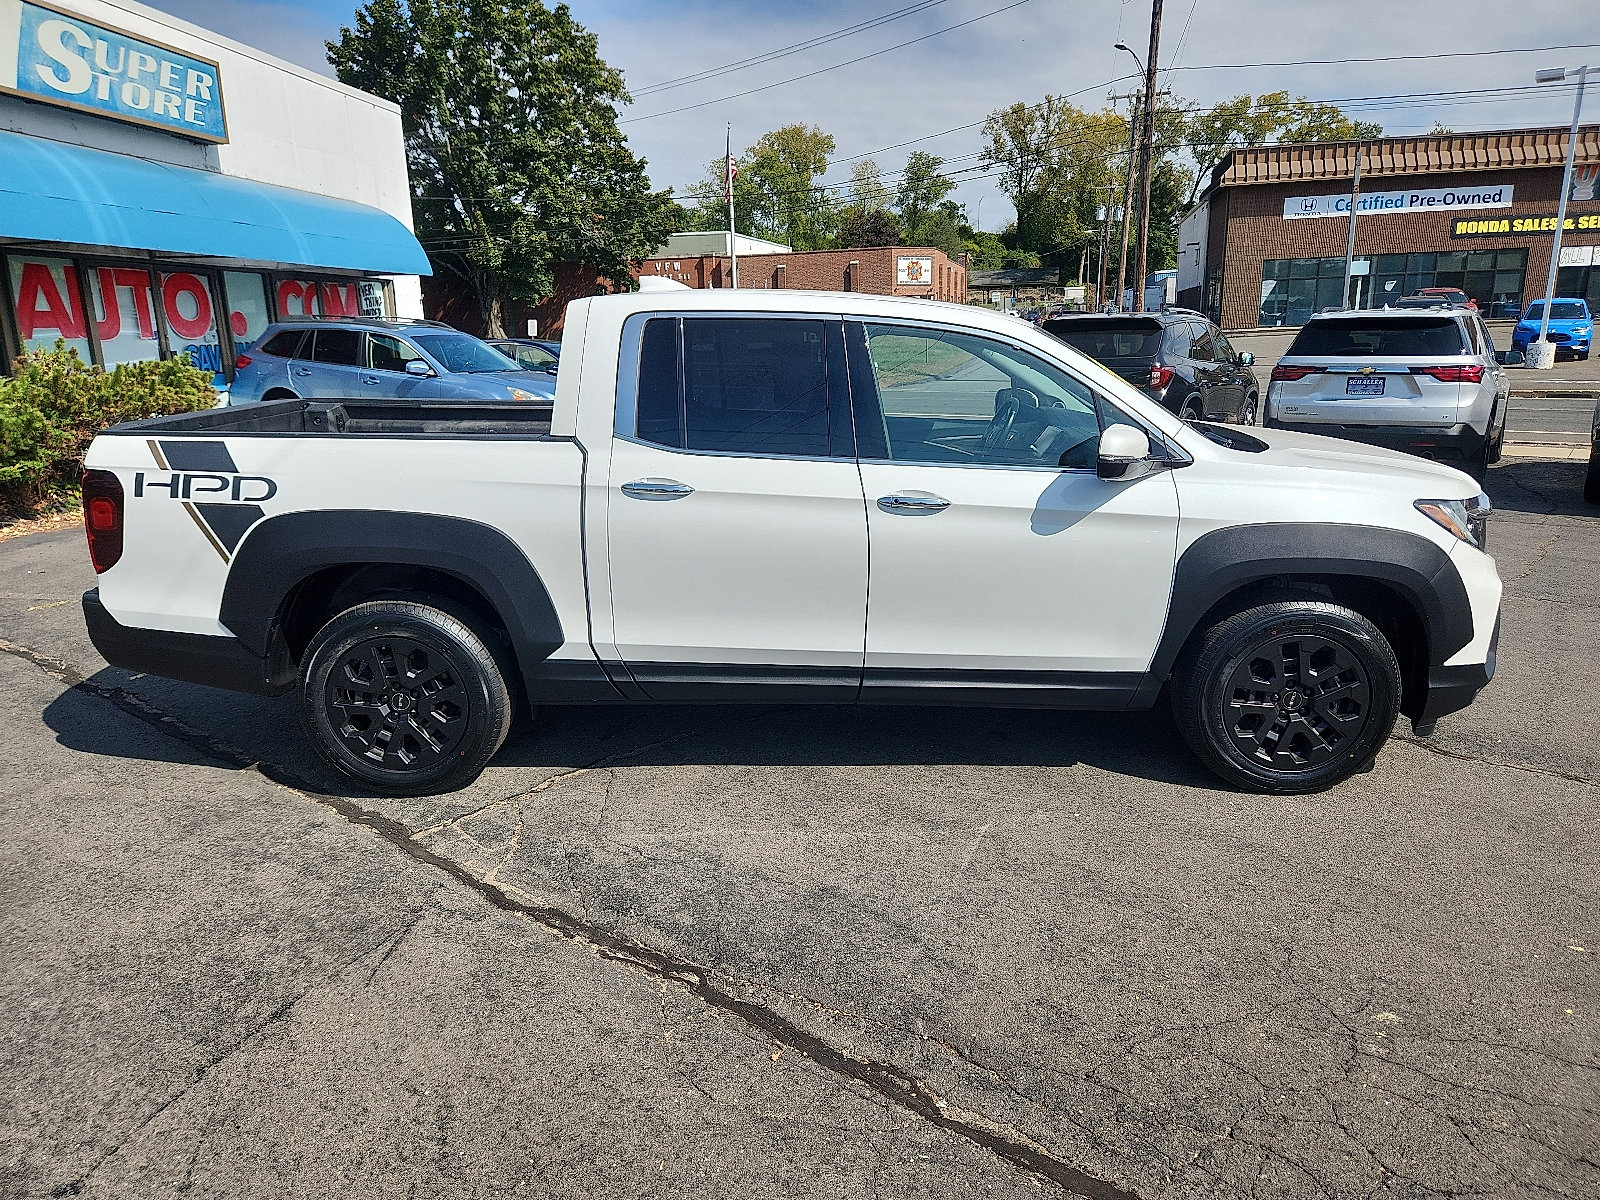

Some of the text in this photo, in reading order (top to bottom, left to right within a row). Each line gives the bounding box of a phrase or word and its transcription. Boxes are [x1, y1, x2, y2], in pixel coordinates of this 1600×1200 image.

[35, 19, 213, 101] SUPER
[1334, 188, 1503, 212] Certified Pre-Owned
[1456, 215, 1600, 234] HONDA SALES & SE
[134, 472, 278, 502] HPD
